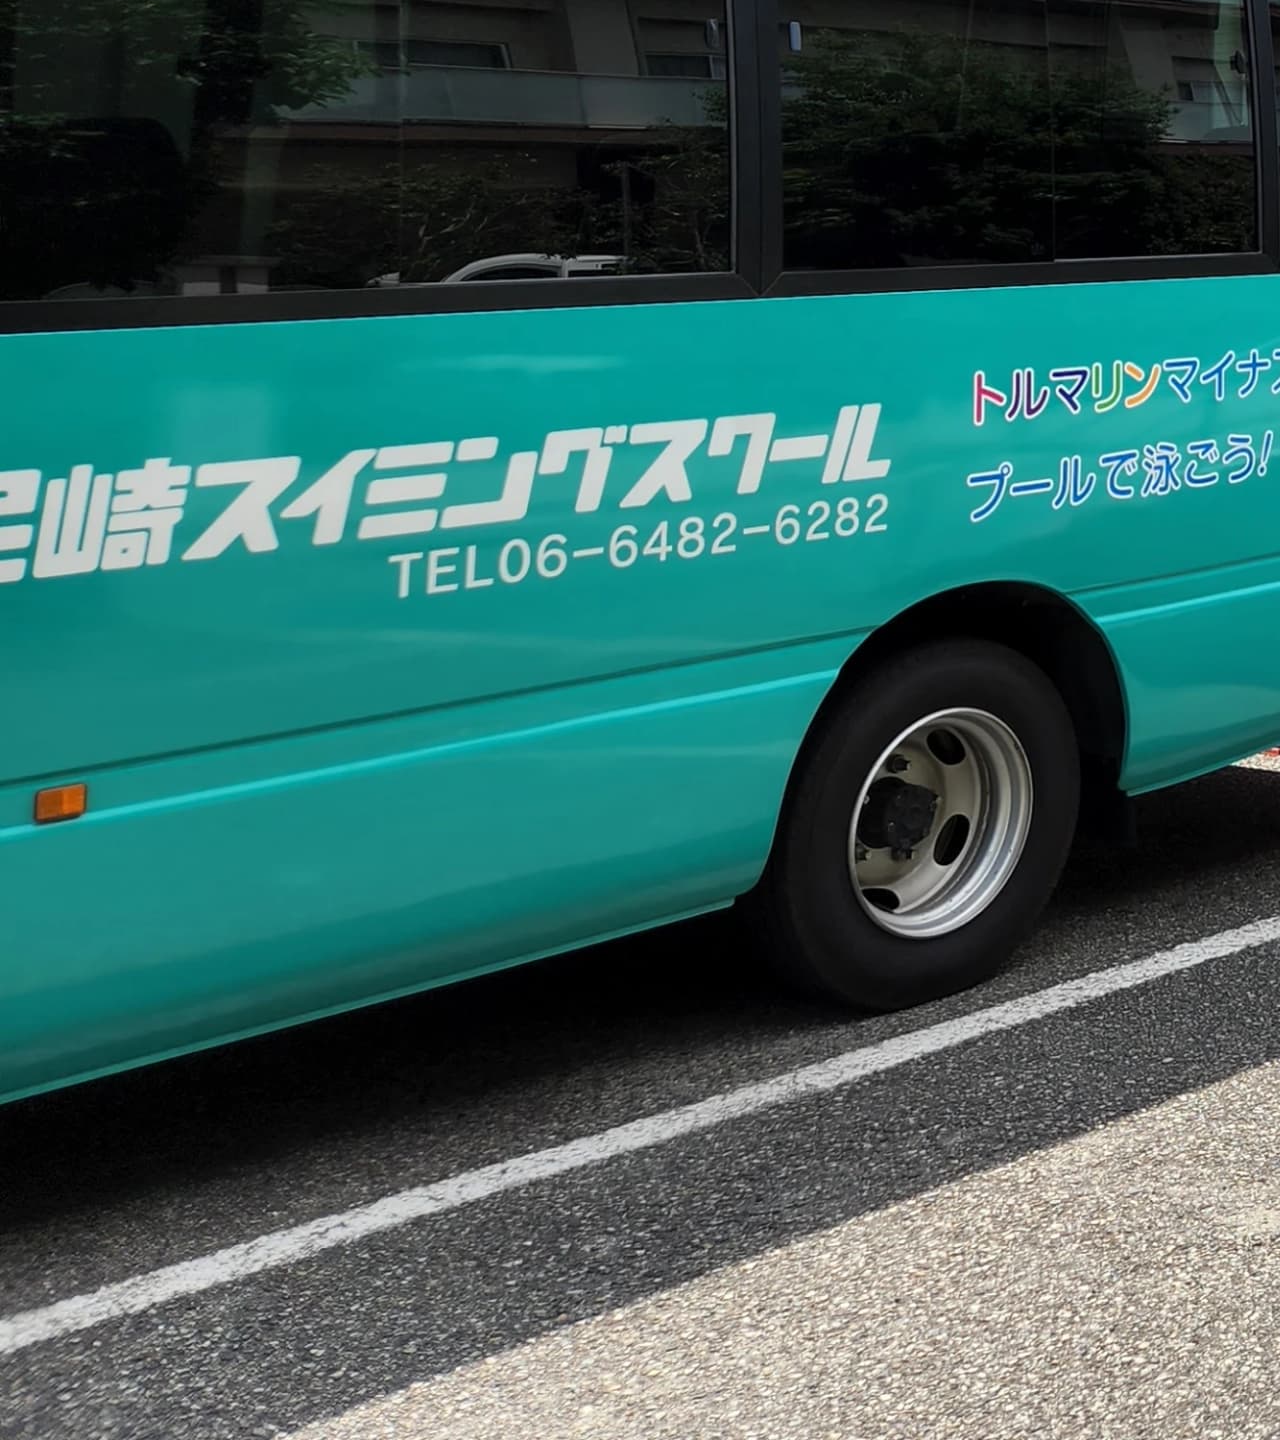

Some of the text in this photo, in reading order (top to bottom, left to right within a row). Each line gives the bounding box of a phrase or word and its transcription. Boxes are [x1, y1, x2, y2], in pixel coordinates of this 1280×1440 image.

[966, 431, 1274, 523] プールで泳ごう!
[388, 493, 890, 599] TEL06-6482-6282
